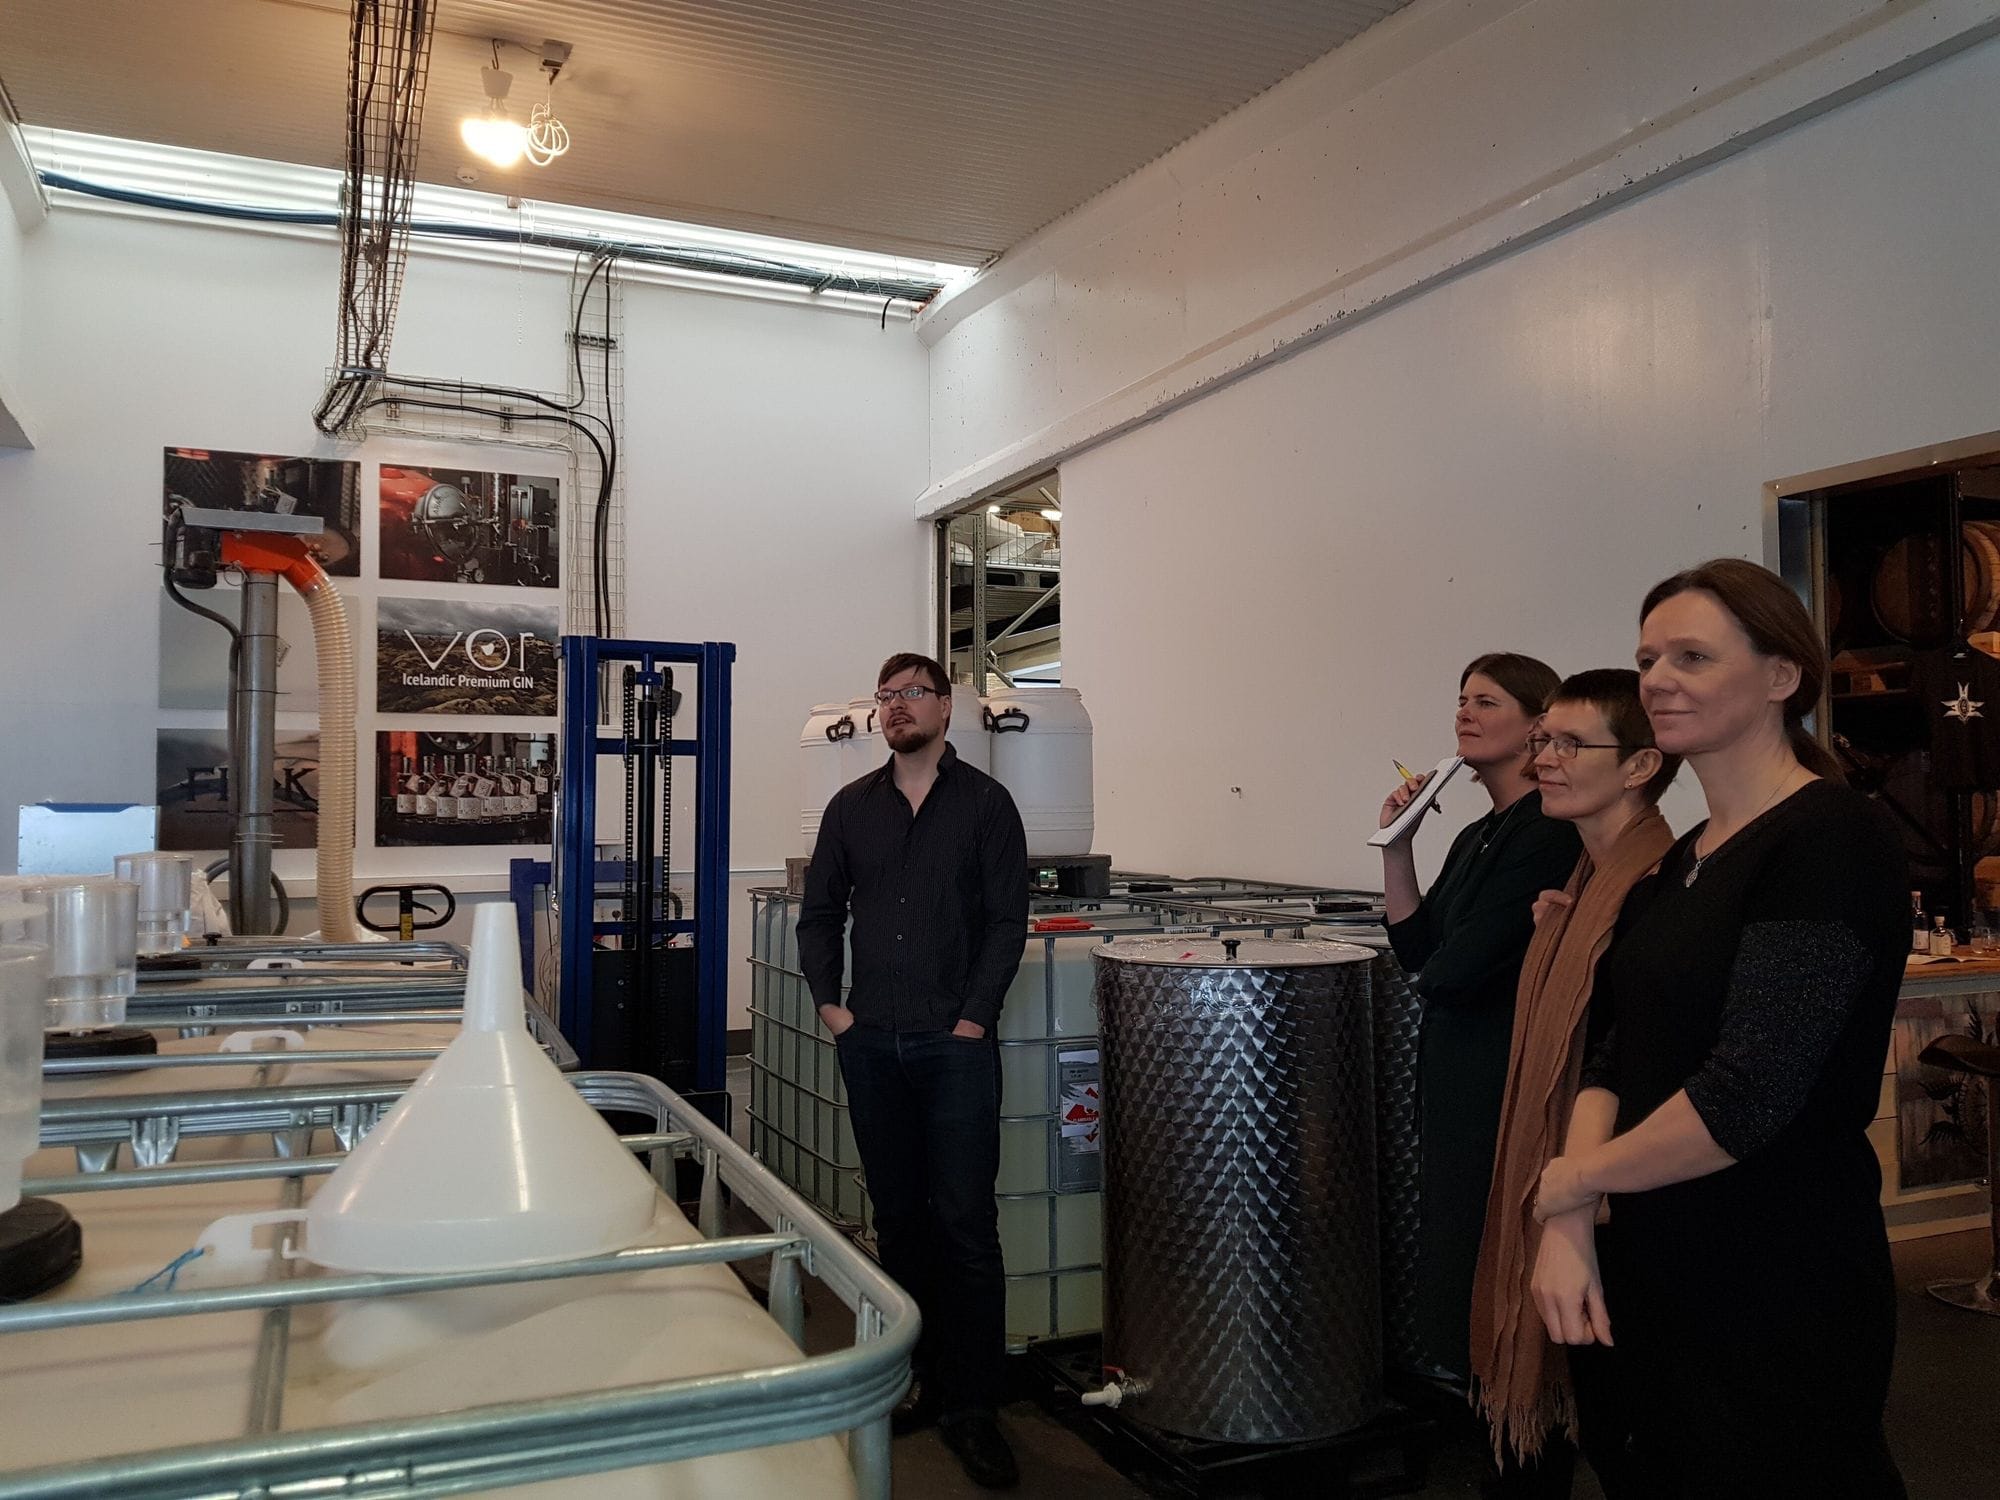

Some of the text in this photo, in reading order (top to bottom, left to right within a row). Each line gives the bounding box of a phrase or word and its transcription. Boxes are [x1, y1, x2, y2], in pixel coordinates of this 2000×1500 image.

[402, 673, 534, 689] Icelandic Premium GIN
